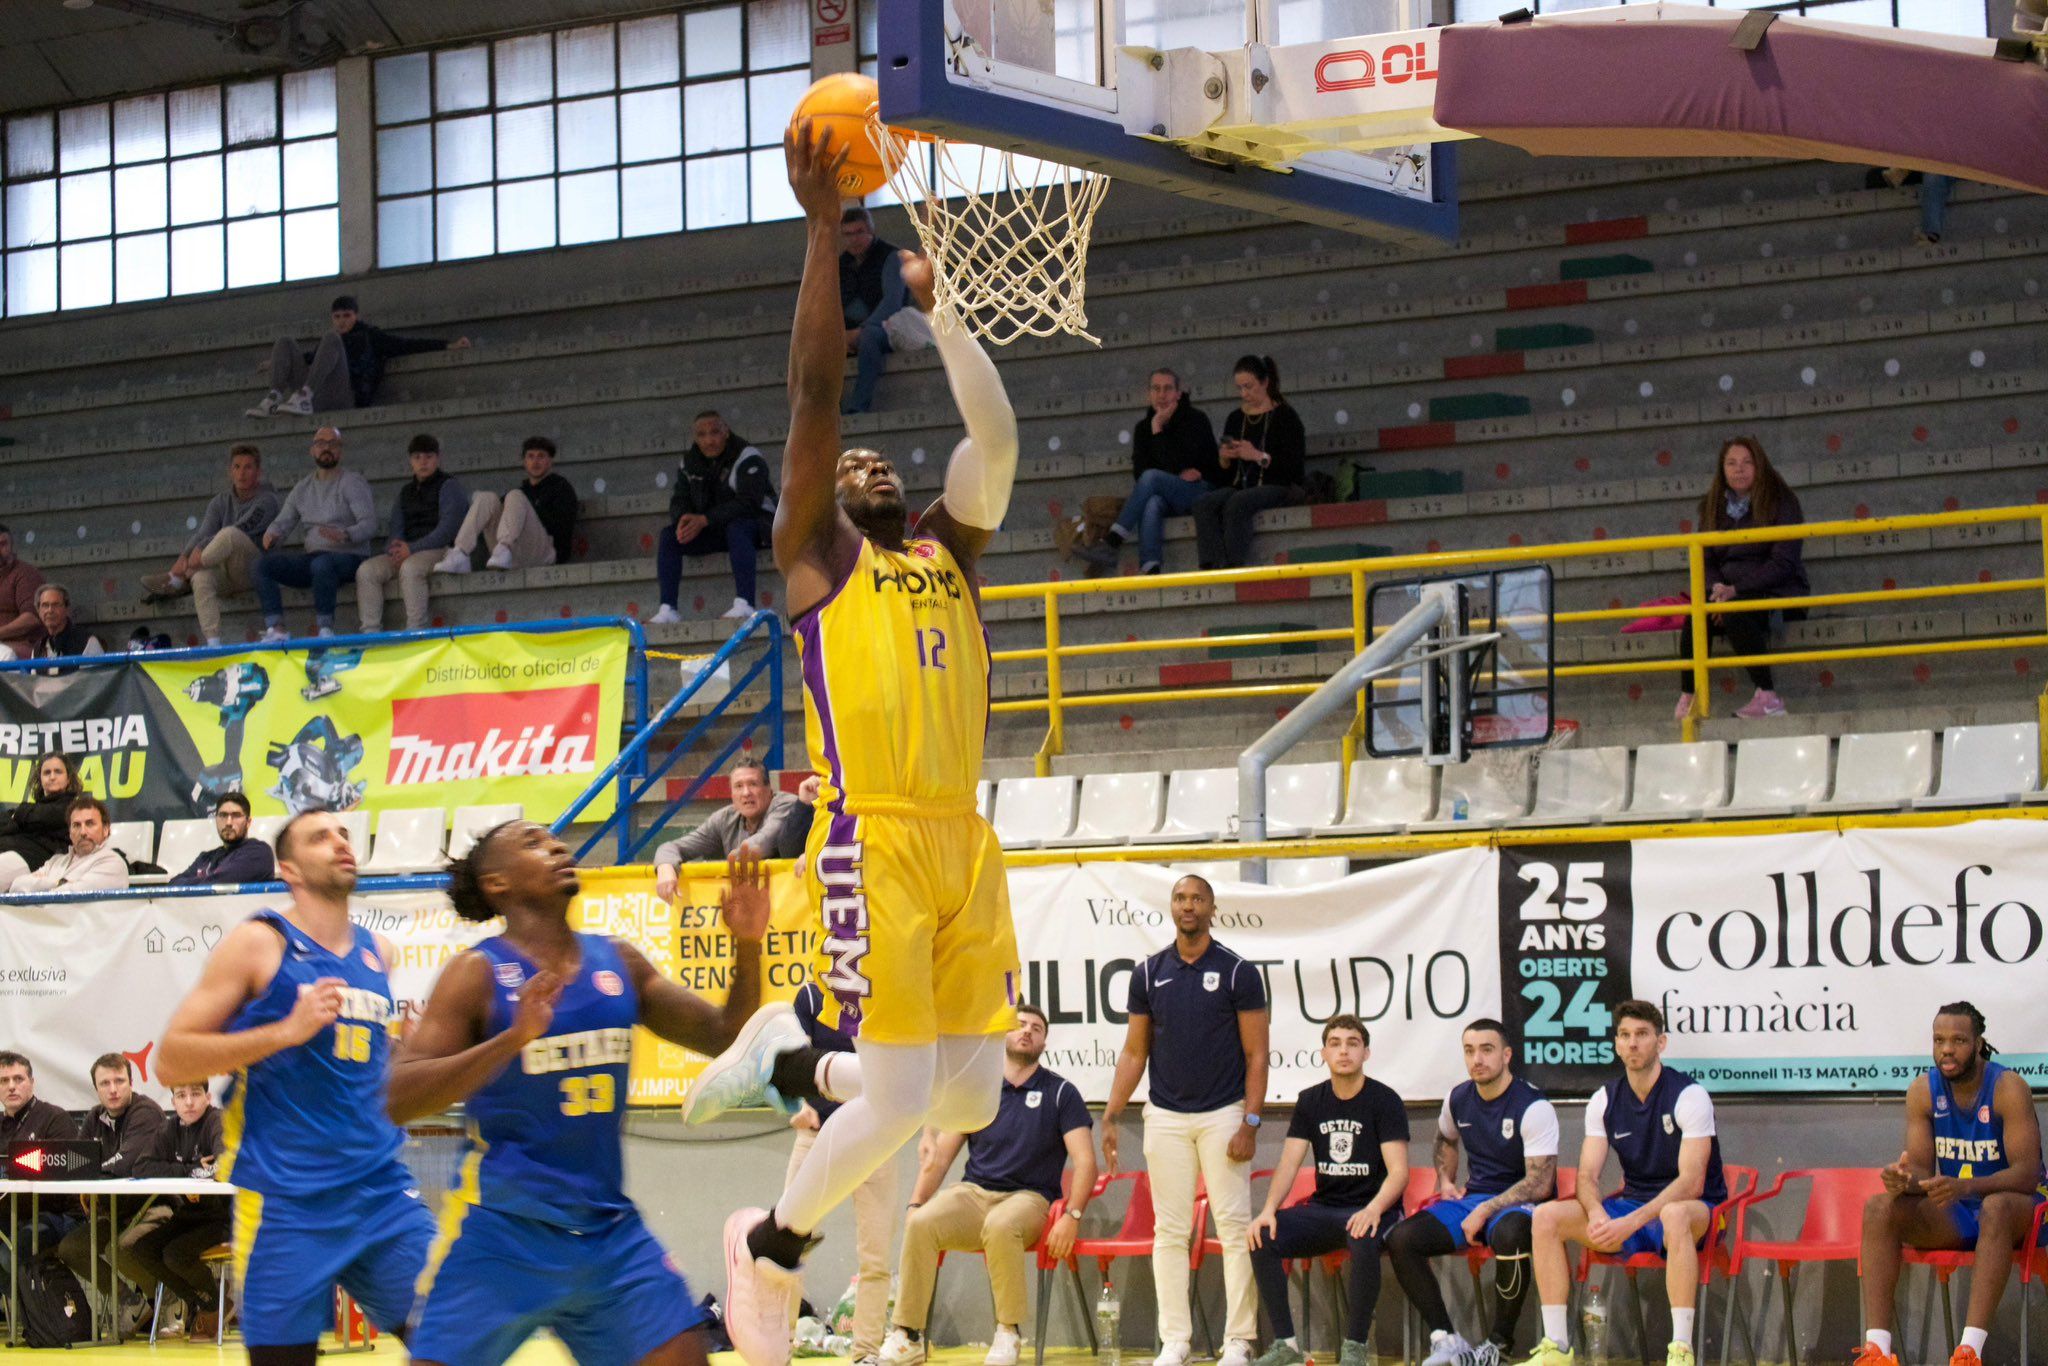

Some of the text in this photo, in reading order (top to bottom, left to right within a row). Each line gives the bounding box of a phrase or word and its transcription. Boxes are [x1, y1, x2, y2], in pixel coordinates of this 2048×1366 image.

[873, 567, 960, 599] HOMS
[916, 627, 947, 670] 12
[426, 656, 600, 684] Distribuidor oficial de
[1518, 861, 1607, 921] 25
[816, 841, 872, 997] UEM
[1087, 897, 1164, 928] Video
[1518, 923, 1606, 951] ANYS
[8, 965, 67, 982] exclusiva
[1518, 957, 1608, 978] OBERTS
[1248, 950, 1470, 1025] TUDIO
[1520, 981, 1612, 1037] 24
[1660, 986, 1859, 1034] farmàcia
[333, 1022, 372, 1063] 15
[1523, 1040, 1614, 1065] HORES
[1709, 1066, 1778, 1081] O'Donnell
[1783, 1066, 1813, 1080] 11-13
[1816, 1064, 1879, 1080] MATARÓ
[1891, 1066, 1909, 1079] 93
[559, 1073, 615, 1117] 33
[1319, 1119, 1363, 1135] GETAFE
[40, 1154, 67, 1167] POSS
[1934, 1136, 2000, 1162] GETAFE
